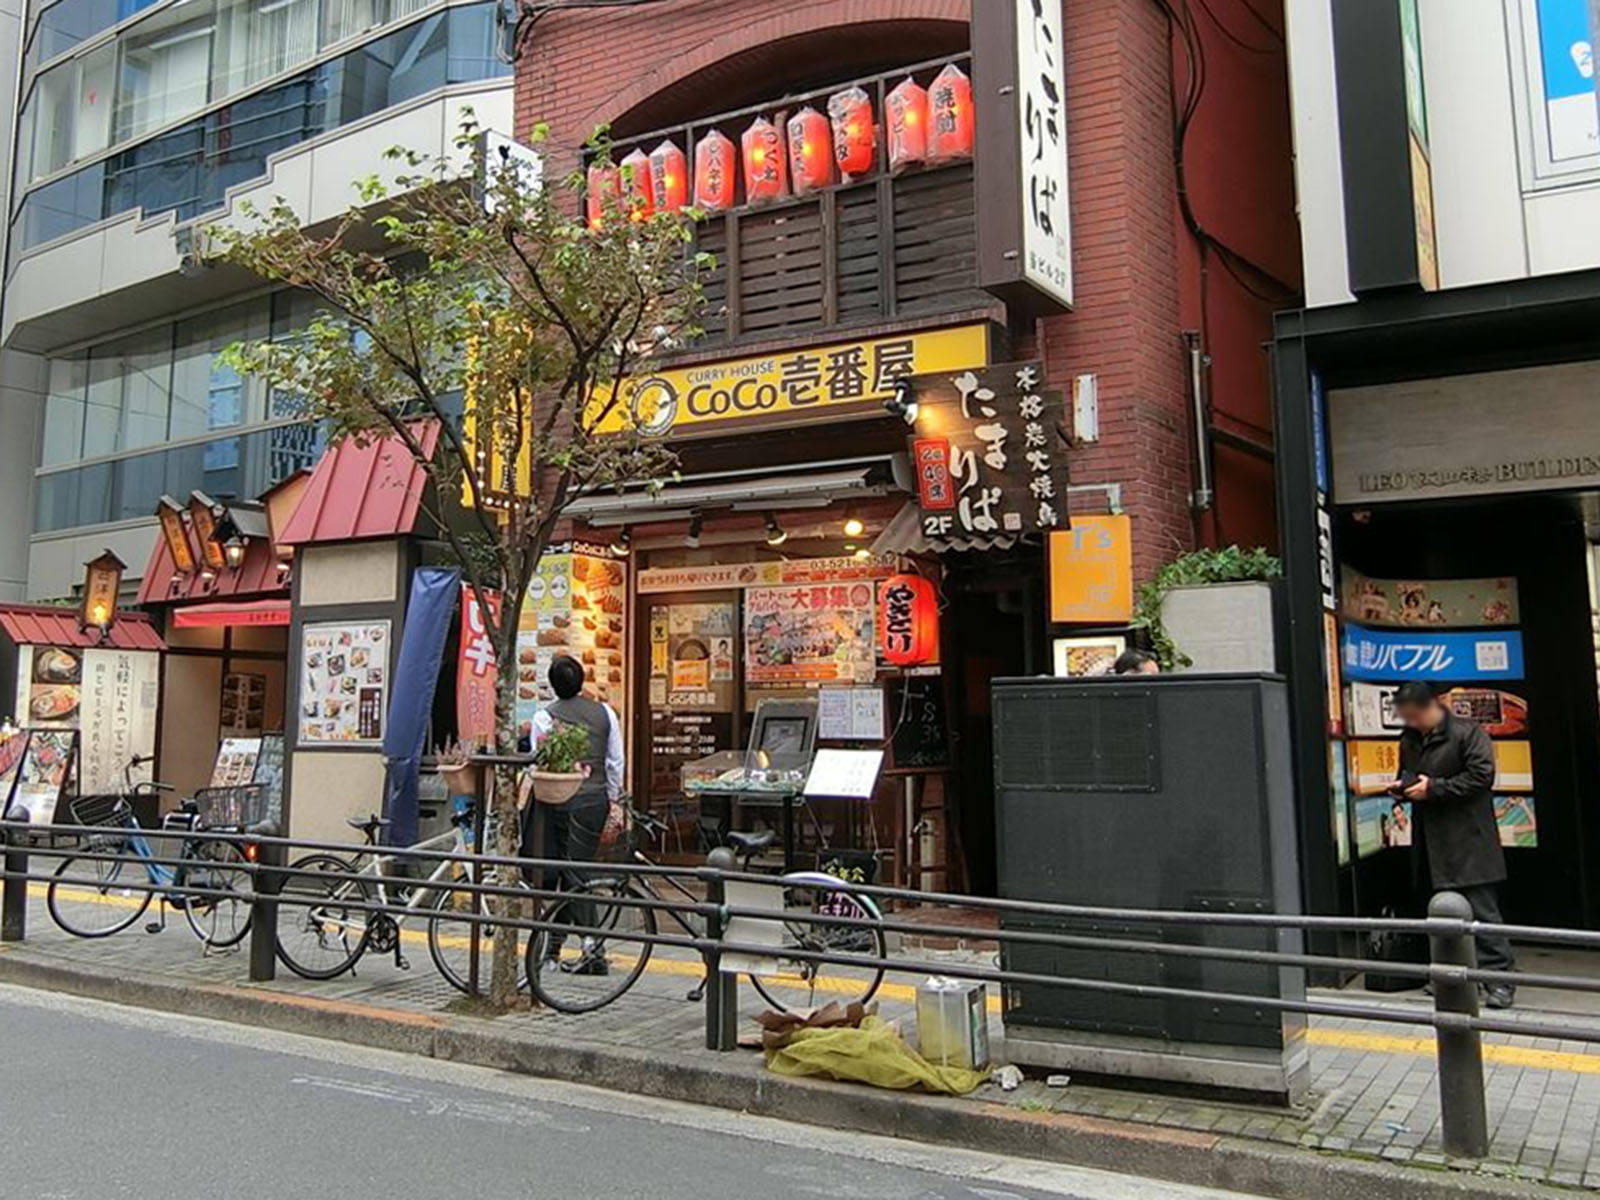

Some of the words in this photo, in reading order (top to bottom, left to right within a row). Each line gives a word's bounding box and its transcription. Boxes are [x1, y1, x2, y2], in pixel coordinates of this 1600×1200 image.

[686, 370, 727, 385] CURRY
[730, 360, 776, 378] HOUSE
[686, 339, 915, 417] CoCo壱番屋
[924, 516, 953, 535] 2F
